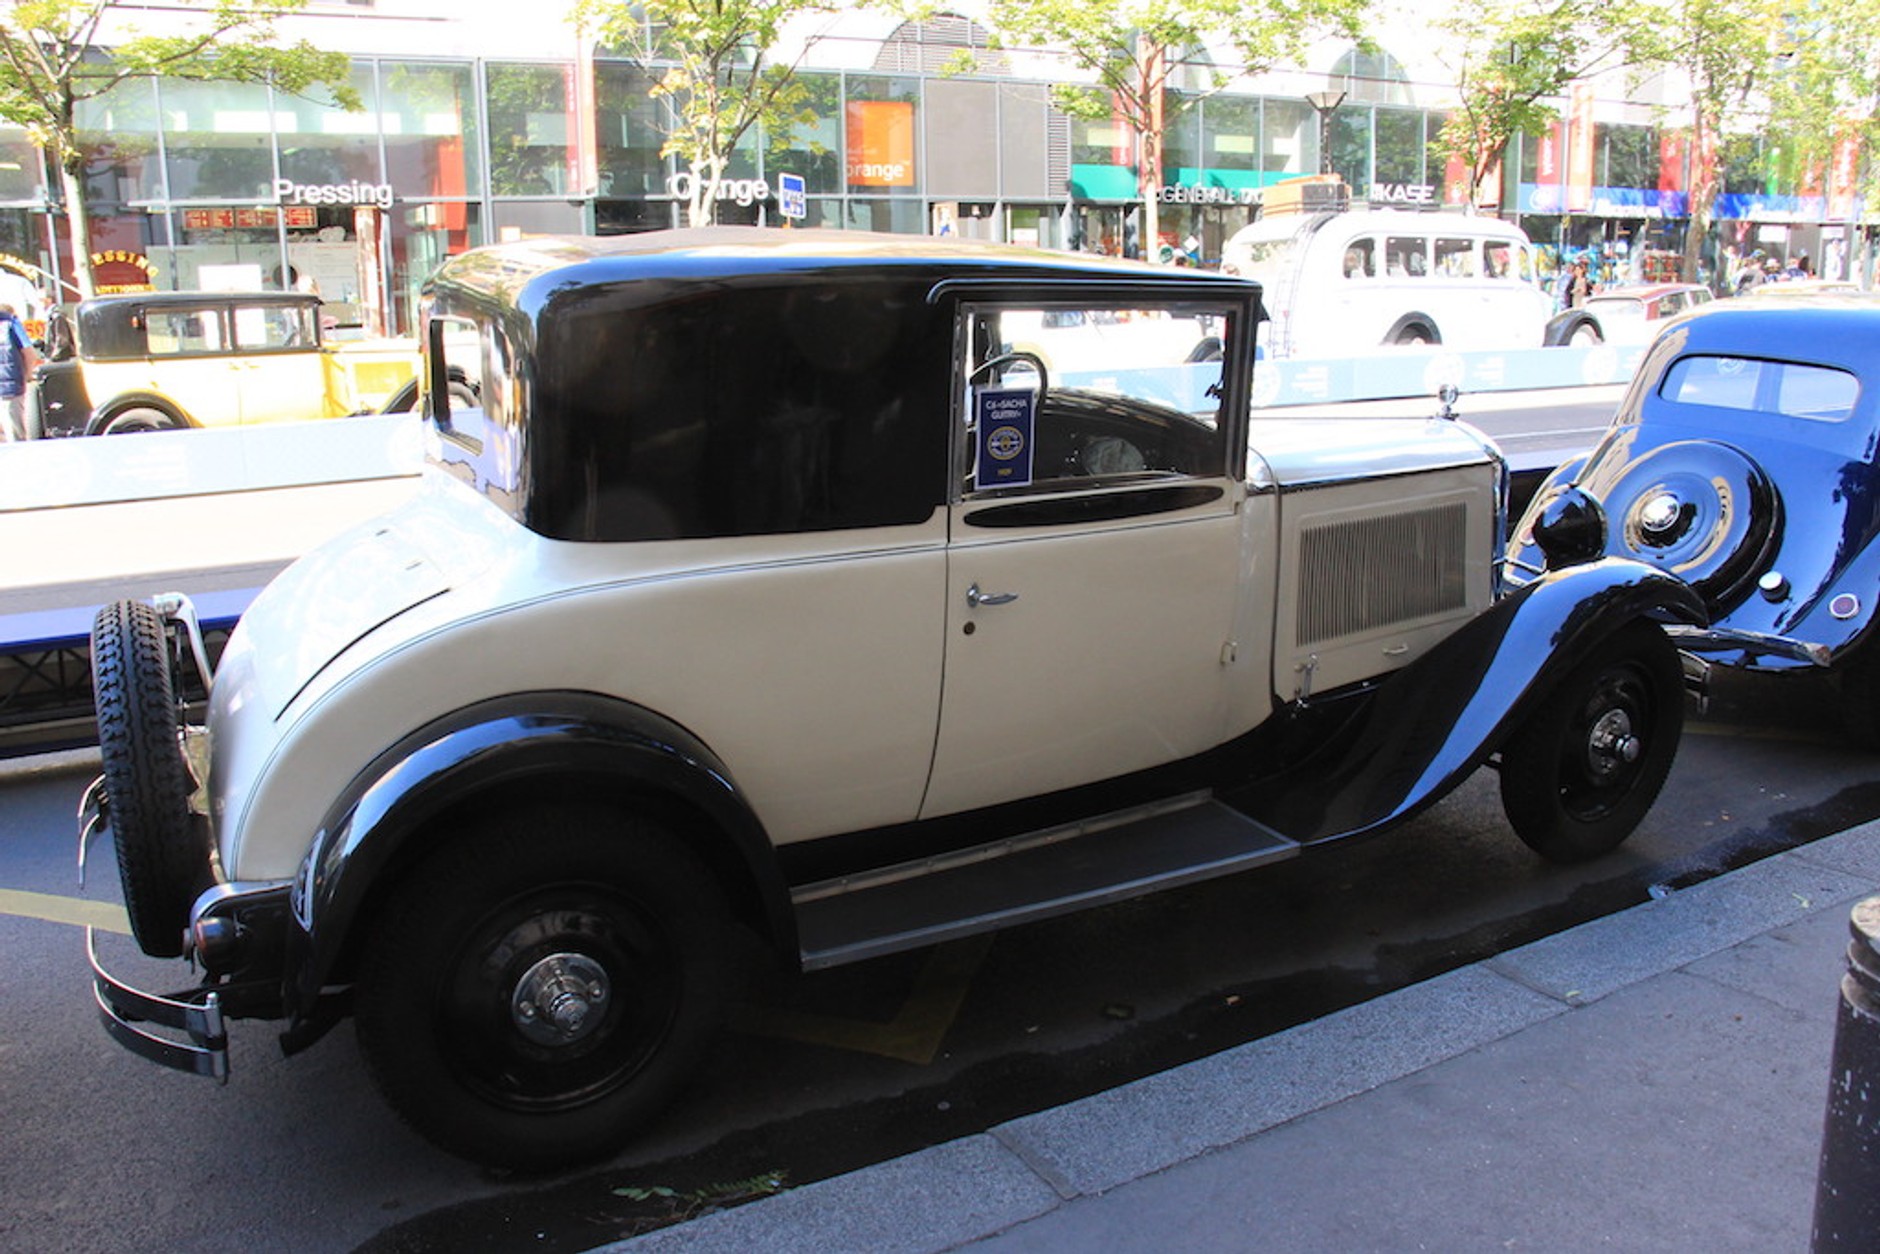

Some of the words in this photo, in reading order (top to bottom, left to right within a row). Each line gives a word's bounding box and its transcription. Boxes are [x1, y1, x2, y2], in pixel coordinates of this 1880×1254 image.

[274, 178, 394, 209] Pressing
[1163, 182, 1237, 204] GÉNÉRALE
[90, 249, 159, 278] ESSING
